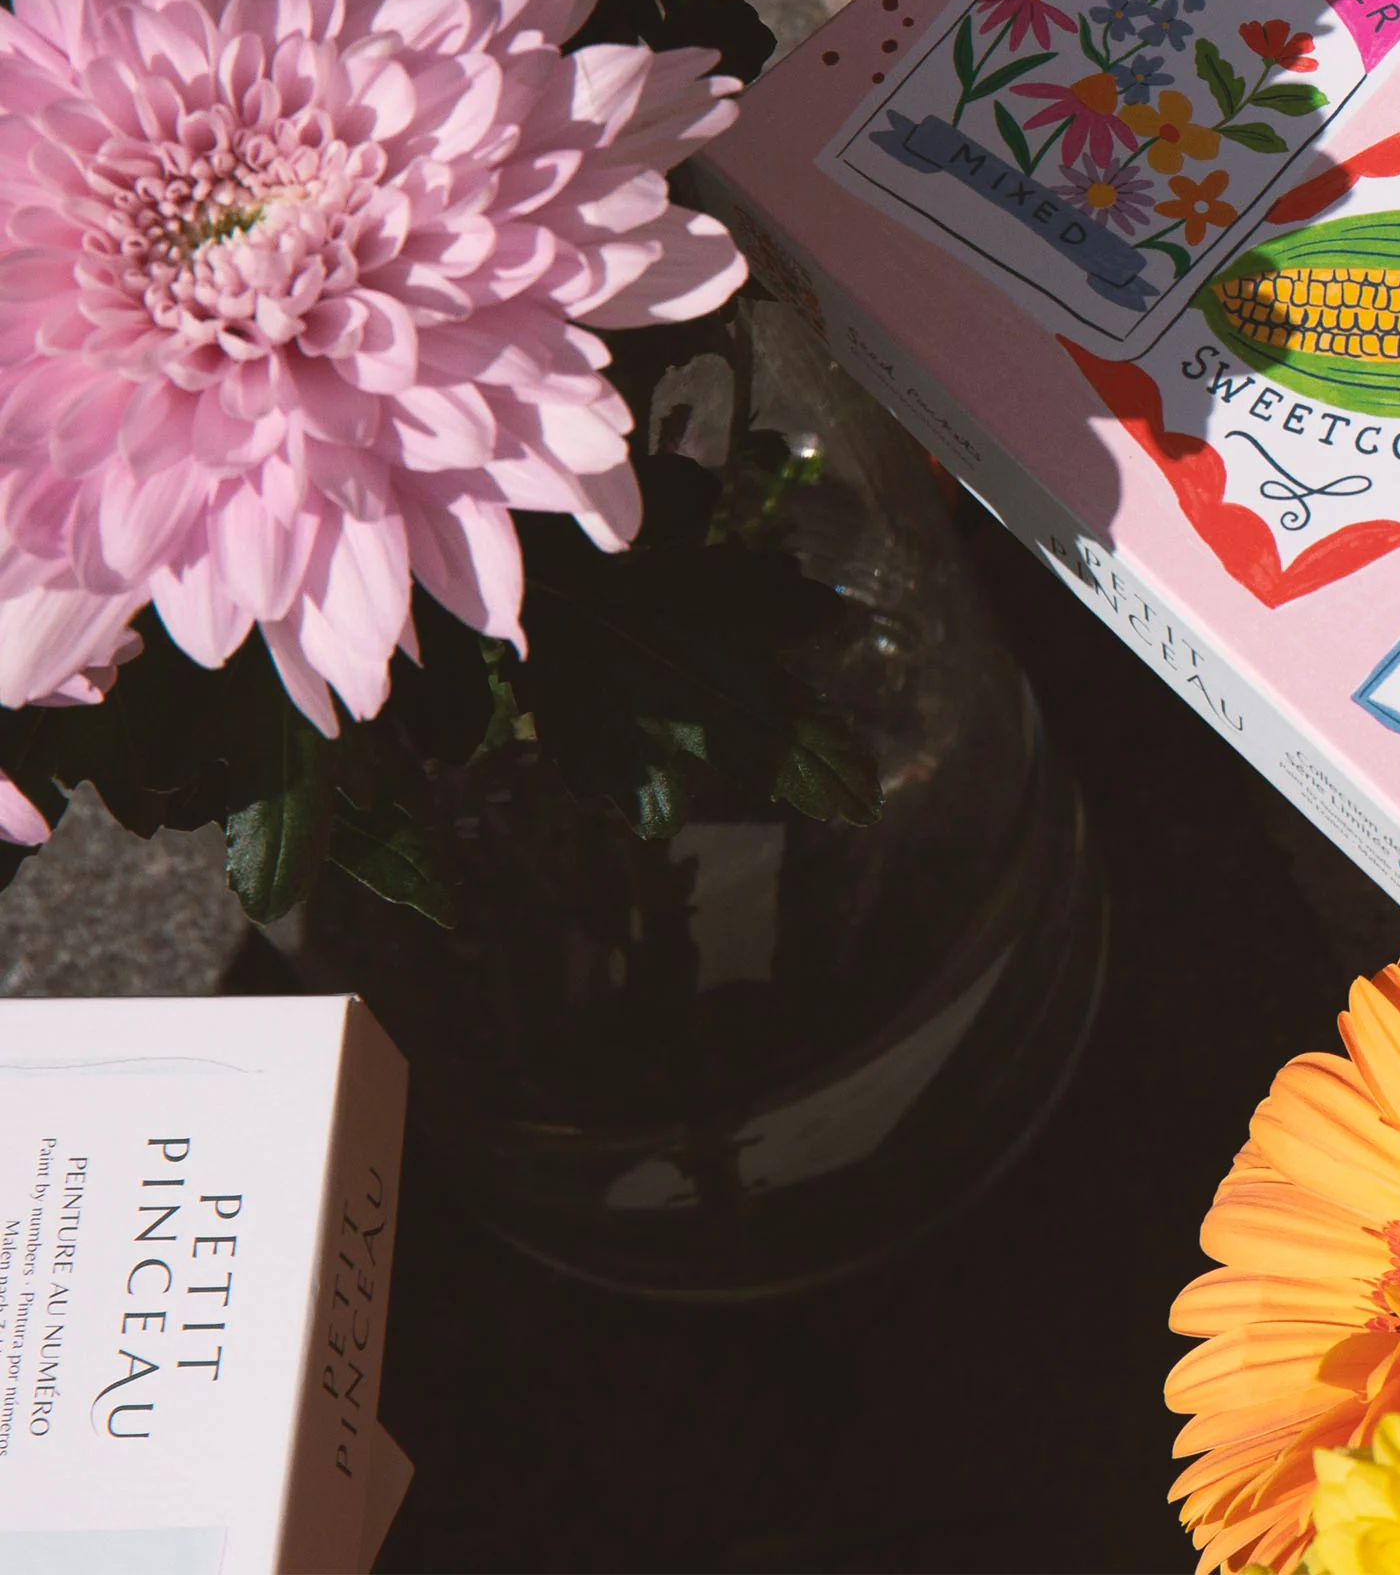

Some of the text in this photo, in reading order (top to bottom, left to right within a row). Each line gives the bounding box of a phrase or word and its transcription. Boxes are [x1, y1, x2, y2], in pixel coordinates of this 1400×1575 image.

[952, 144, 1087, 248] MIXED
[1050, 536, 1244, 735] PINCEAU
[1084, 547, 1205, 667] PETIT
[29, 1180, 49, 1200] by
[39, 1136, 58, 1177] Paint
[2, 1219, 19, 1272] Malen
[24, 1205, 45, 1278] numbers
[29, 1156, 89, 1437] PEINTURE AU NUMÉRO
[90, 1138, 191, 1439] PINCEAU
[177, 1194, 243, 1381] PETIT
[17, 1292, 37, 1348] Pintura
[321, 1199, 363, 1399] PETIT
[334, 1166, 385, 1479] PINCEAU
[7, 1353, 23, 1382] por
